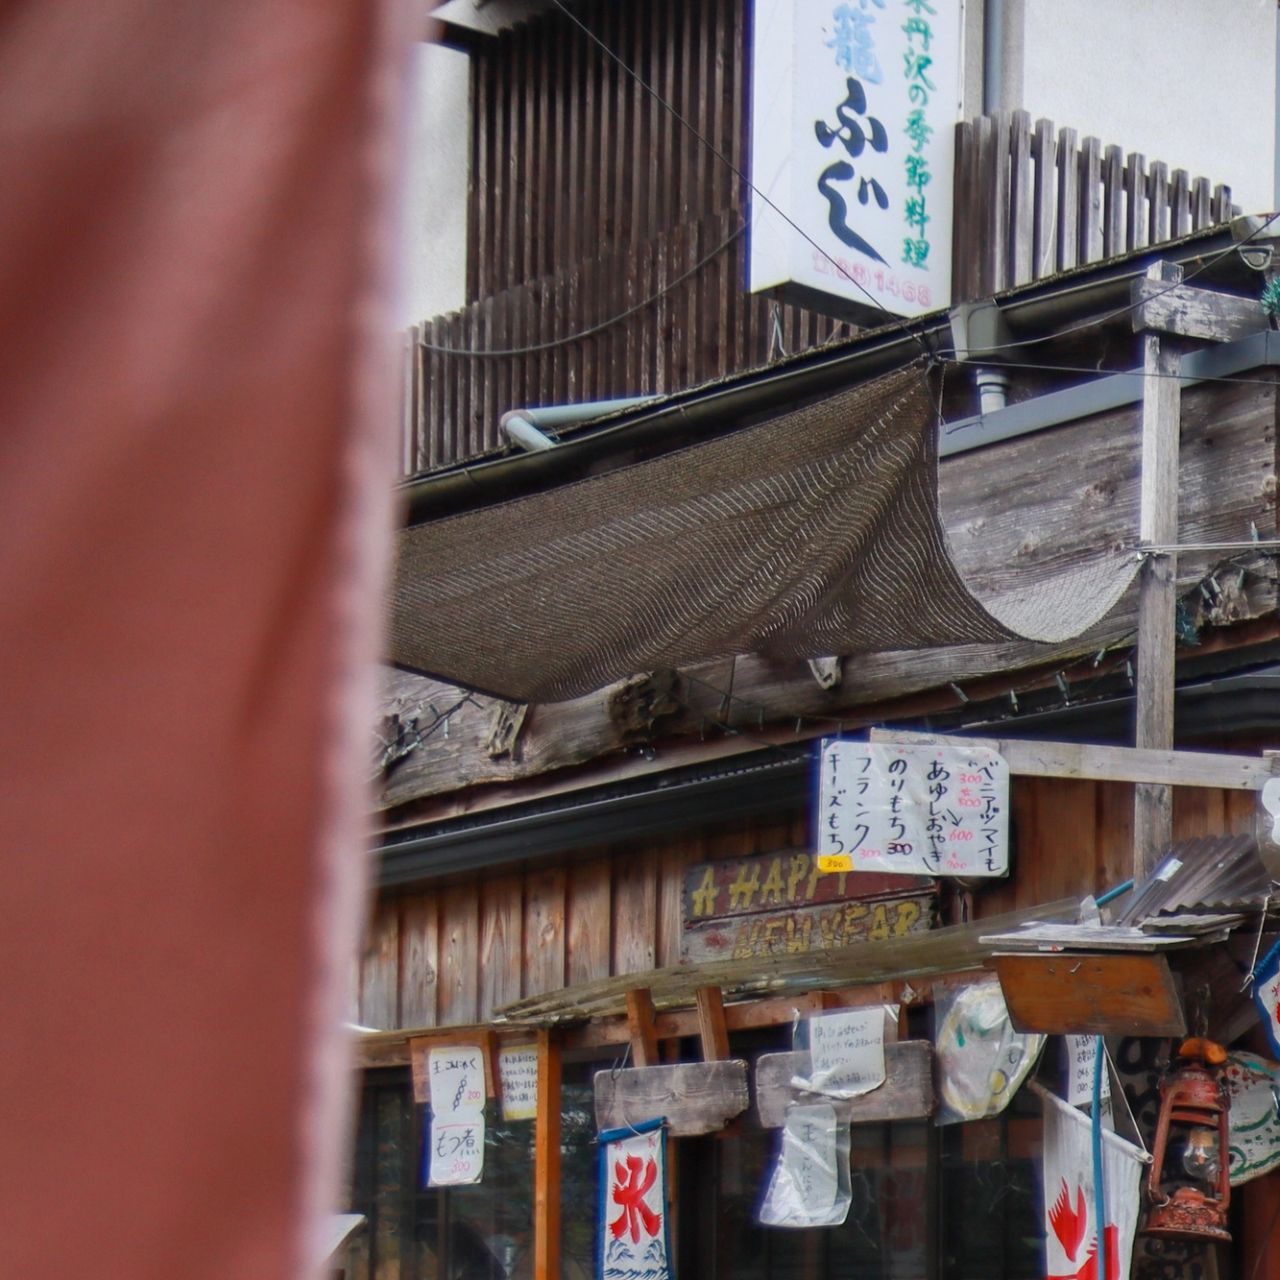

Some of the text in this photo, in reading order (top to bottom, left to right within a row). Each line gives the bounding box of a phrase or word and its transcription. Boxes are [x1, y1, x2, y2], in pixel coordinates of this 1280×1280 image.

[848, 757, 872, 854] フランク
[888, 759, 908, 841] のりもち
[886, 842, 913, 855] 300
[692, 866, 719, 916] A
[436, 1127, 480, 1158] もつ煮
[608, 1151, 662, 1246] 氷
